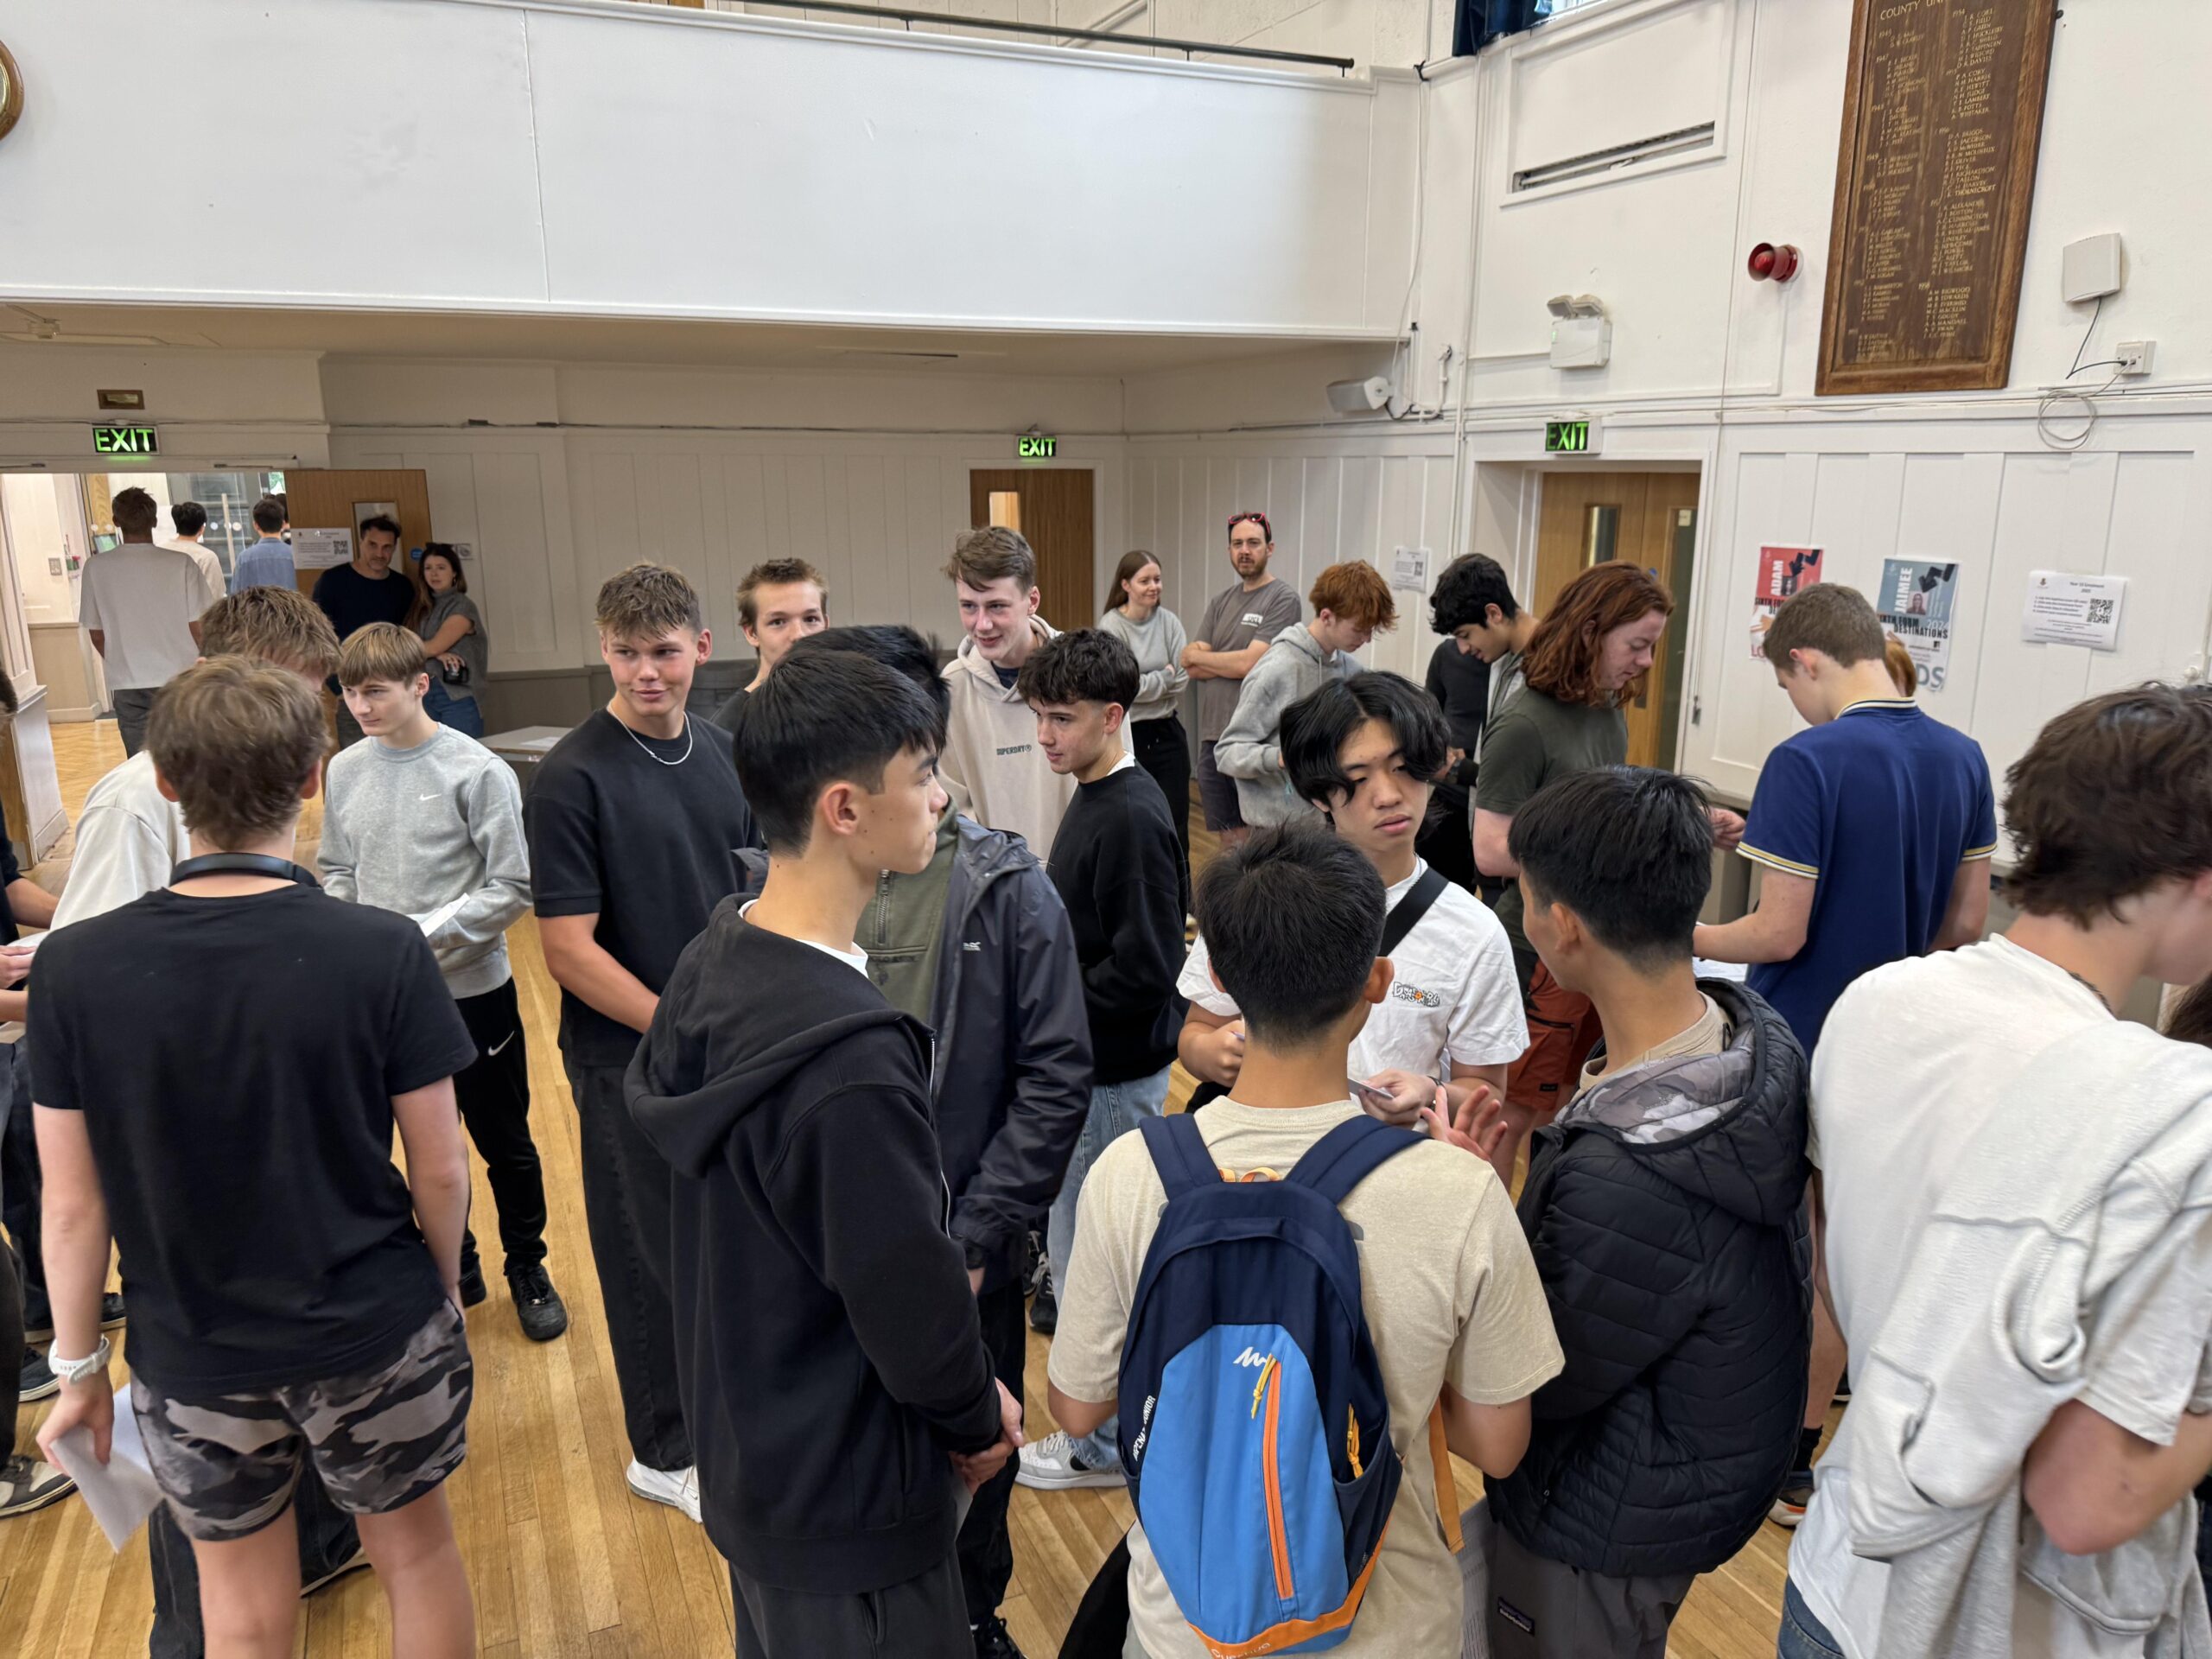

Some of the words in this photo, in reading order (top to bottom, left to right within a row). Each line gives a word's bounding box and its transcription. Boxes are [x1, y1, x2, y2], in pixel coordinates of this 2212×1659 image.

[1880, 1, 1920, 21] COUNTY
[1970, 55, 1992, 66] DAVIES
[1968, 68, 1986, 77] CORY
[1965, 93, 1991, 104] LAMBERT
[1955, 156, 1976, 165] OLIVER
[94, 428, 154, 452] EXIT
[1548, 423, 1589, 450] EXIT
[1020, 437, 1056, 457] EXIT
[1770, 560, 1784, 595] ADAM
[1893, 567, 1913, 614] JAIMEE
[1893, 623, 1948, 639] DESTINATIONS
[1898, 616, 1919, 628] FORM
